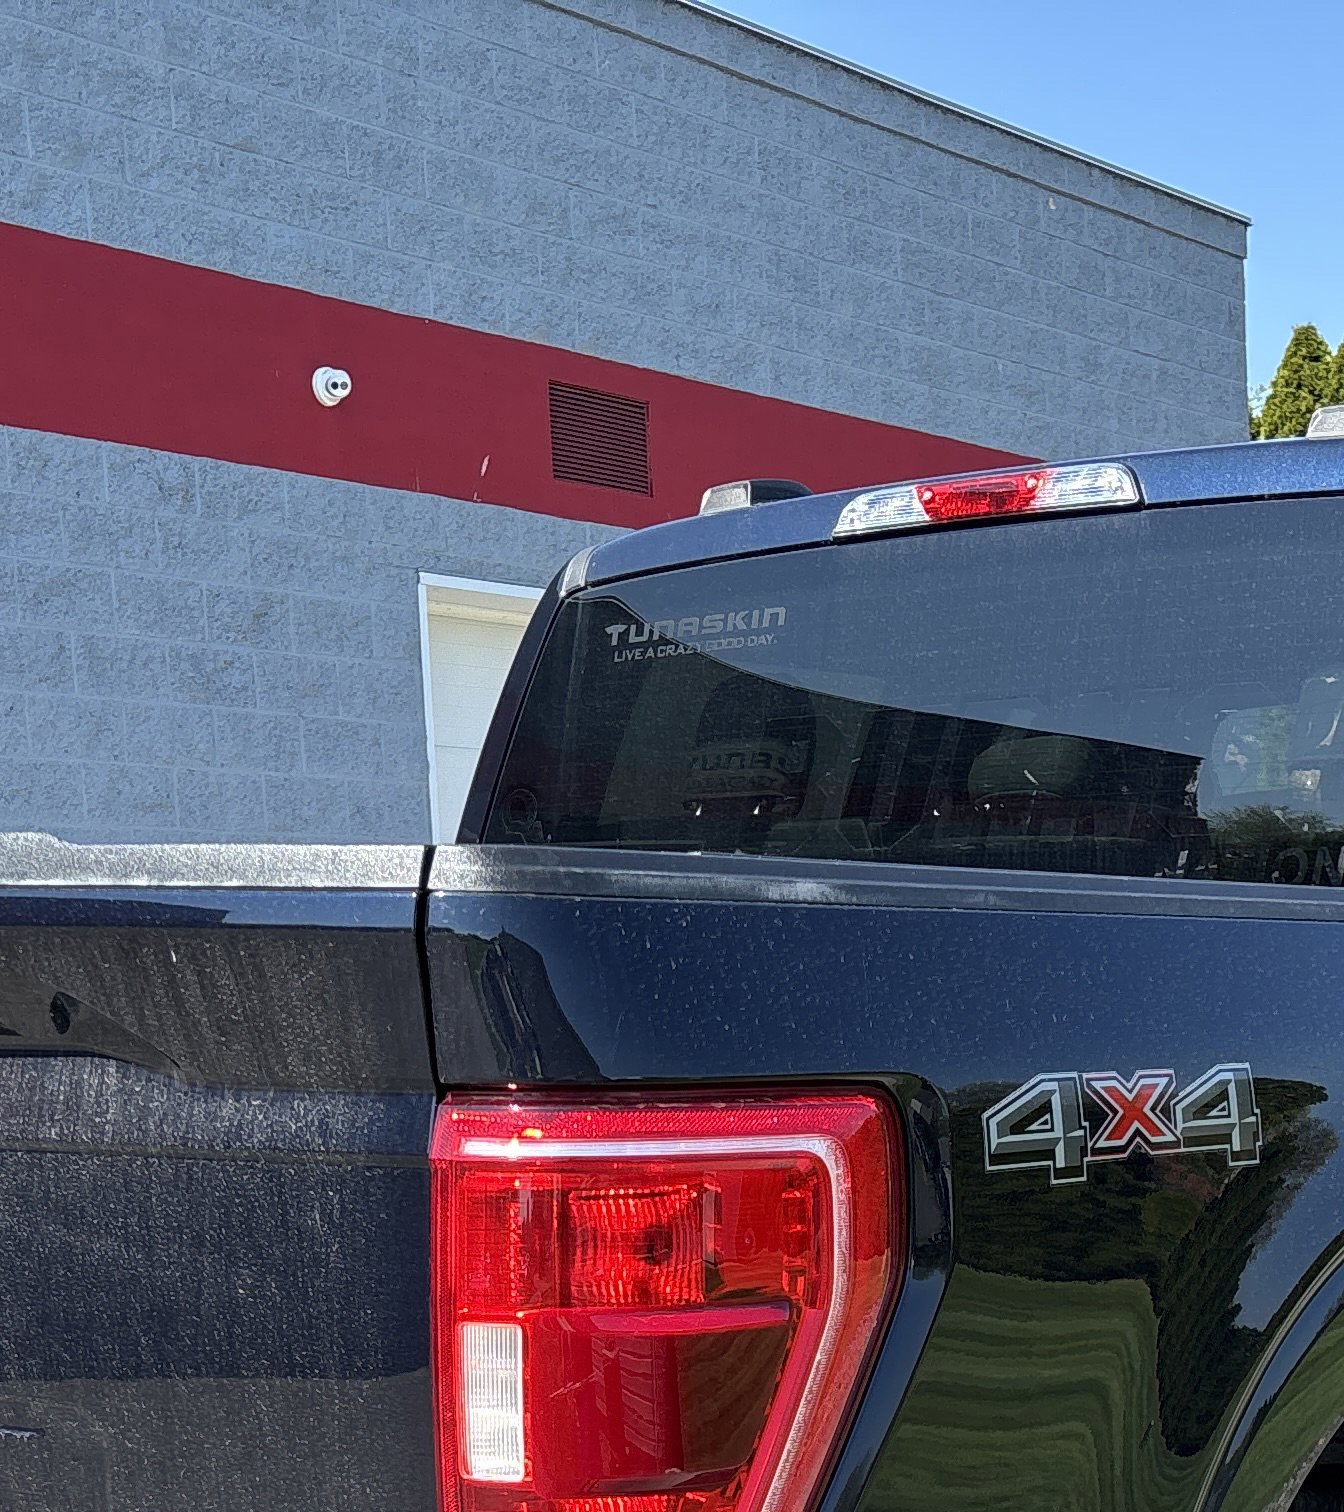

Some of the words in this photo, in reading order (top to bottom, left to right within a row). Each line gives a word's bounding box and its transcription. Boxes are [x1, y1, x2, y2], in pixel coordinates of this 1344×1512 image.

[605, 606, 786, 647] TUNASKIN
[613, 648, 644, 663] LIVE
[645, 646, 655, 660] A
[657, 641, 701, 658] CRAZY
[706, 636, 745, 652] GOOD
